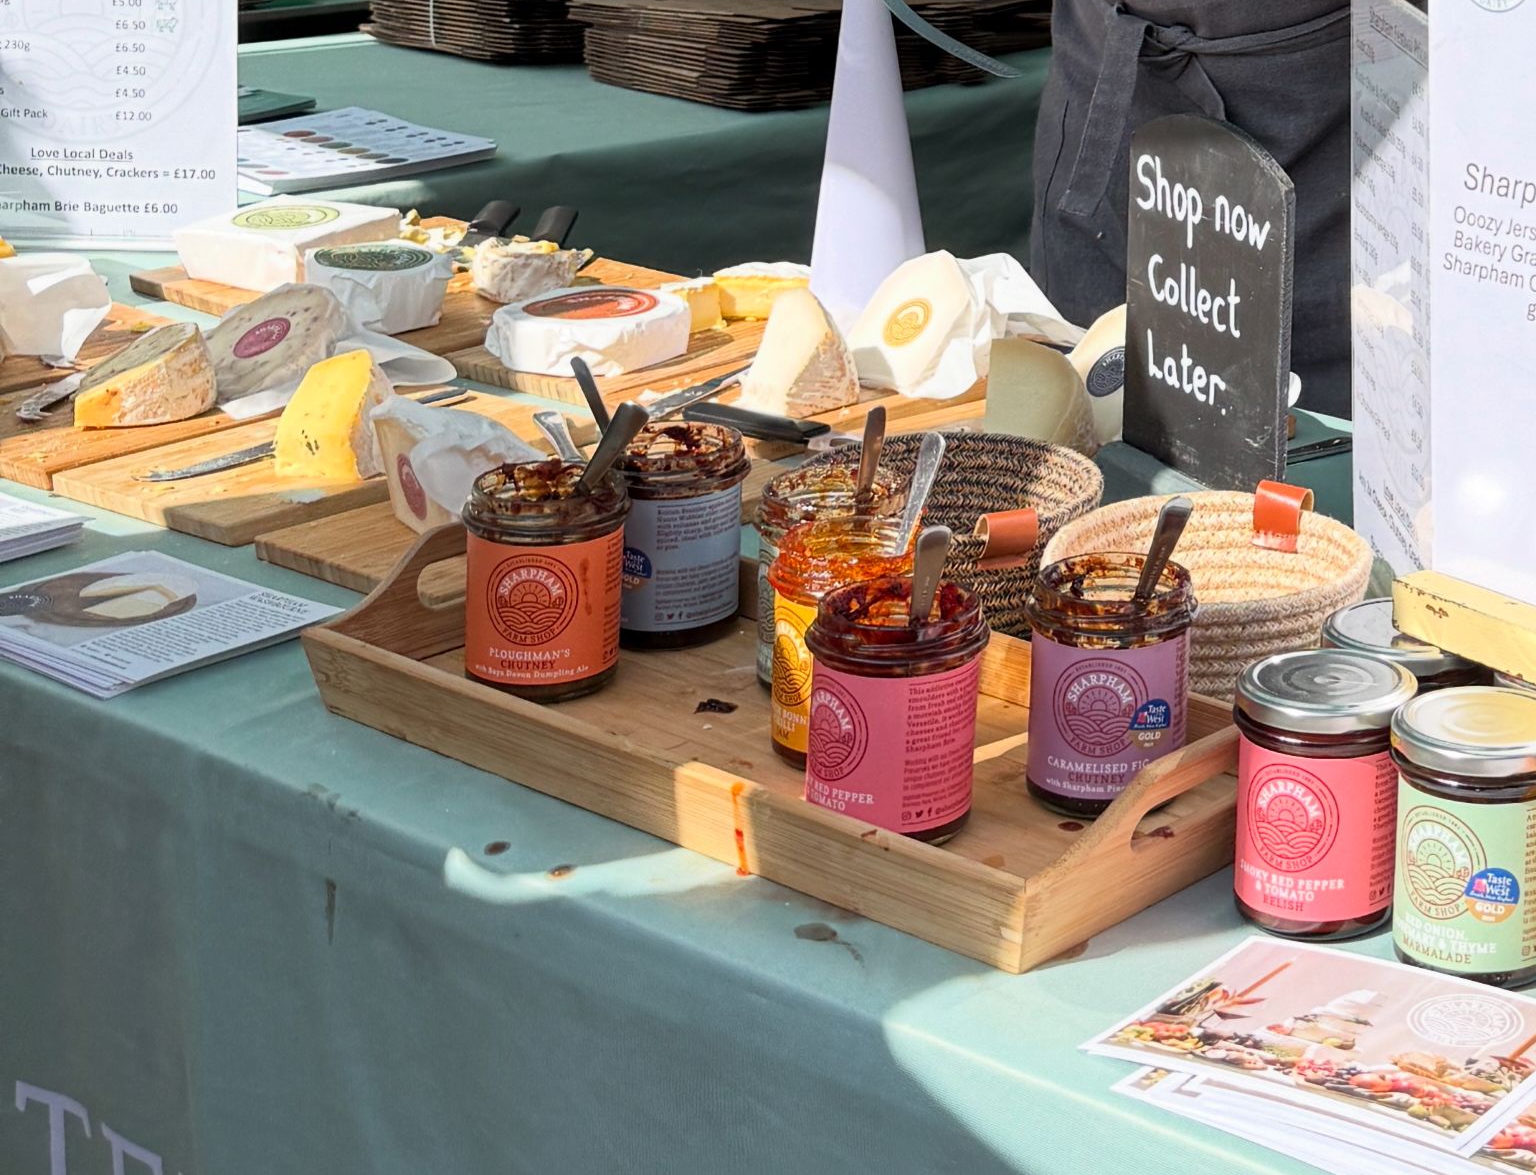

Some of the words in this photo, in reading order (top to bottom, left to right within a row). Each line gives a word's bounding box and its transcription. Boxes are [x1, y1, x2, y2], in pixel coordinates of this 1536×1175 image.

[0, 107, 21, 119] Gift
[23, 108, 48, 119] Pack
[31, 146, 60, 159] Love
[63, 148, 95, 160] Local
[99, 149, 133, 161] Deals
[47, 164, 103, 180] Chutney,
[106, 166, 159, 179] Crackers
[174, 168, 216, 181] £17.00
[54, 200, 79, 213] Brie
[84, 201, 140, 215] Baguette
[144, 203, 178, 214] £6.00
[1136, 153, 1202, 249] Shop
[1214, 195, 1271, 251] now
[1453, 205, 1502, 238] Ooozy
[1453, 230, 1508, 265] Bakery
[1442, 251, 1525, 295] Sharpham
[1147, 253, 1241, 339] Collect
[500, 567, 563, 596] SHARPHAM
[489, 647, 571, 661] PLOUGHMAN'S
[500, 660, 556, 671] CHUTNEY
[1067, 673, 1133, 704] SHARPHAM
[1137, 730, 1161, 740] GOLD
[1047, 756, 1128, 775] CARAMELISED
[1062, 781, 1104, 794] Sharpham
[1068, 773, 1125, 785] CHUTNEY
[832, 788, 875, 805] PEPPER
[1258, 780, 1322, 819] SHARPHAM
[1265, 883, 1315, 902] TOMATO
[1297, 878, 1345, 891] PEPPER
[1475, 904, 1505, 914] GOLD
[1402, 935, 1472, 964] MARMALADE
[1449, 941, 1497, 954] THYME
